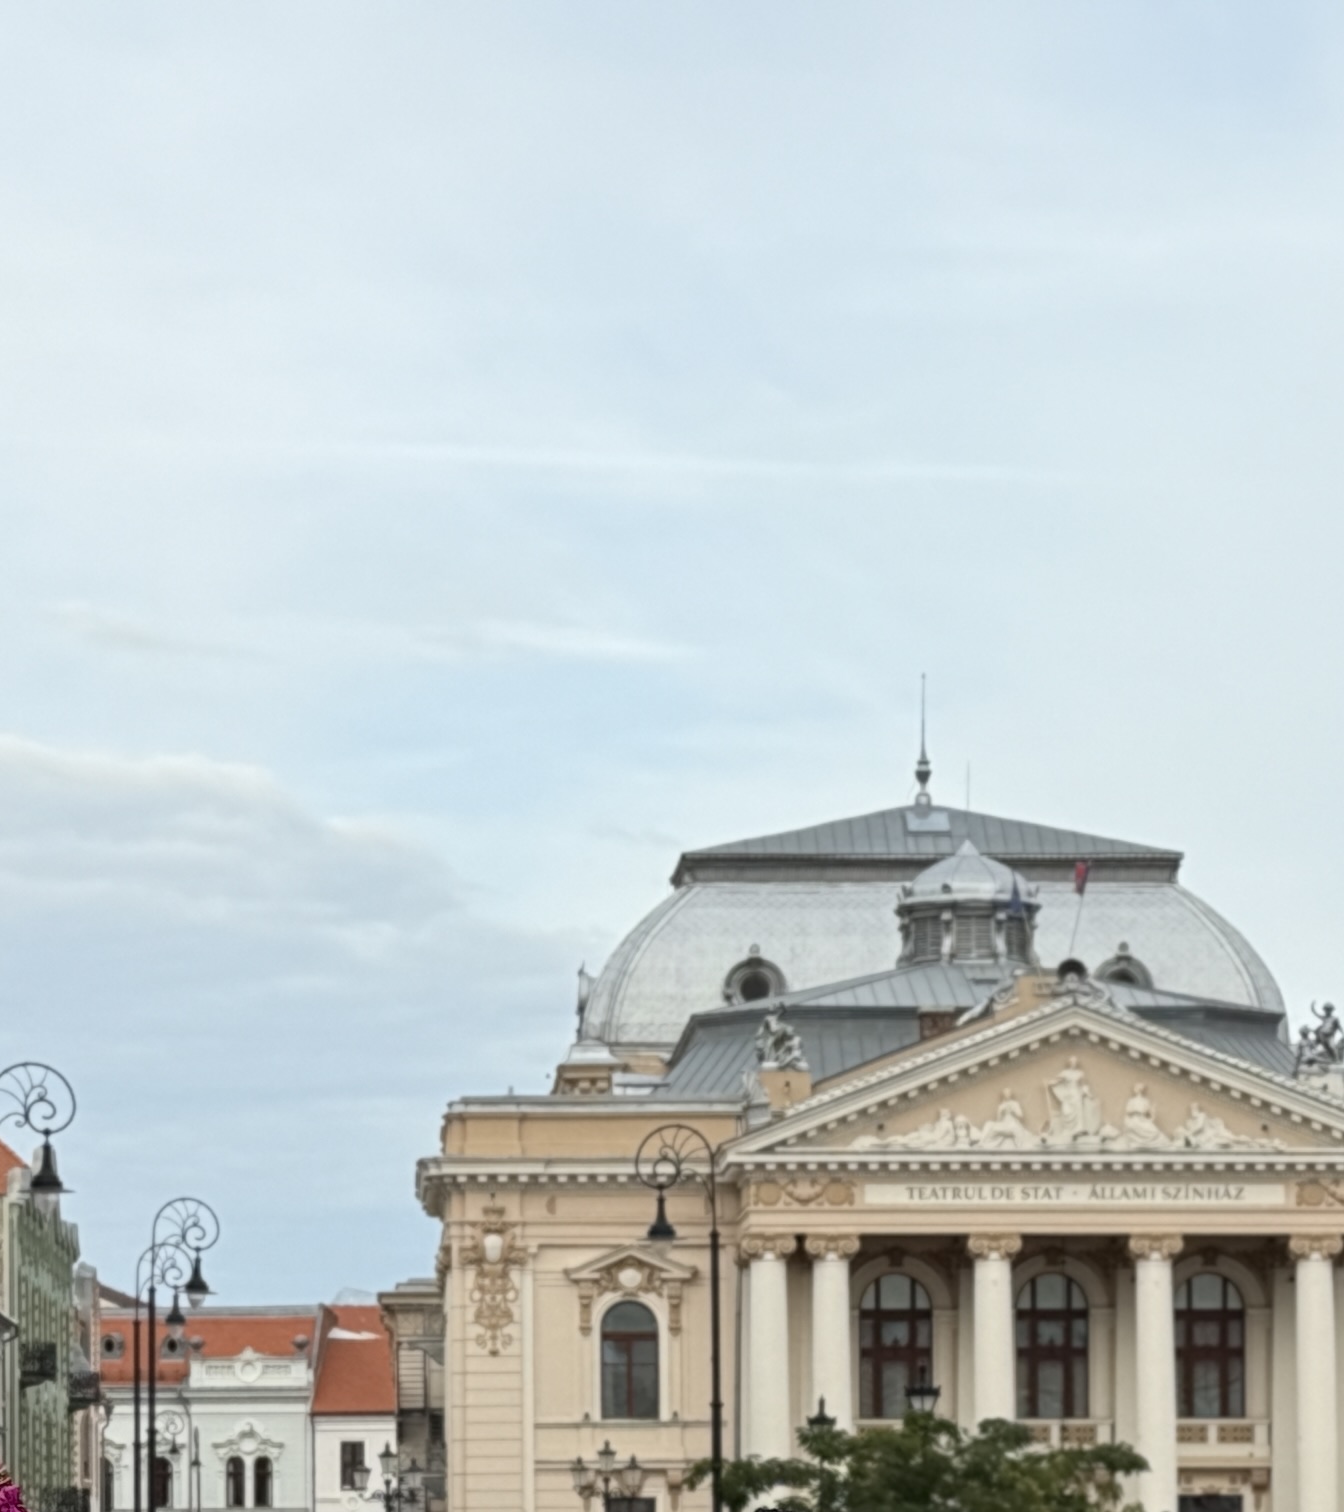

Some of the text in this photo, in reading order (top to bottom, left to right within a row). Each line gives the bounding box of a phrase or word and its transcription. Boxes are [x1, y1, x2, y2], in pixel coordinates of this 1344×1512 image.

[905, 1183, 1245, 1201] TEATRUL DE STAT ÁLLAMI SZÍNHÁZ
